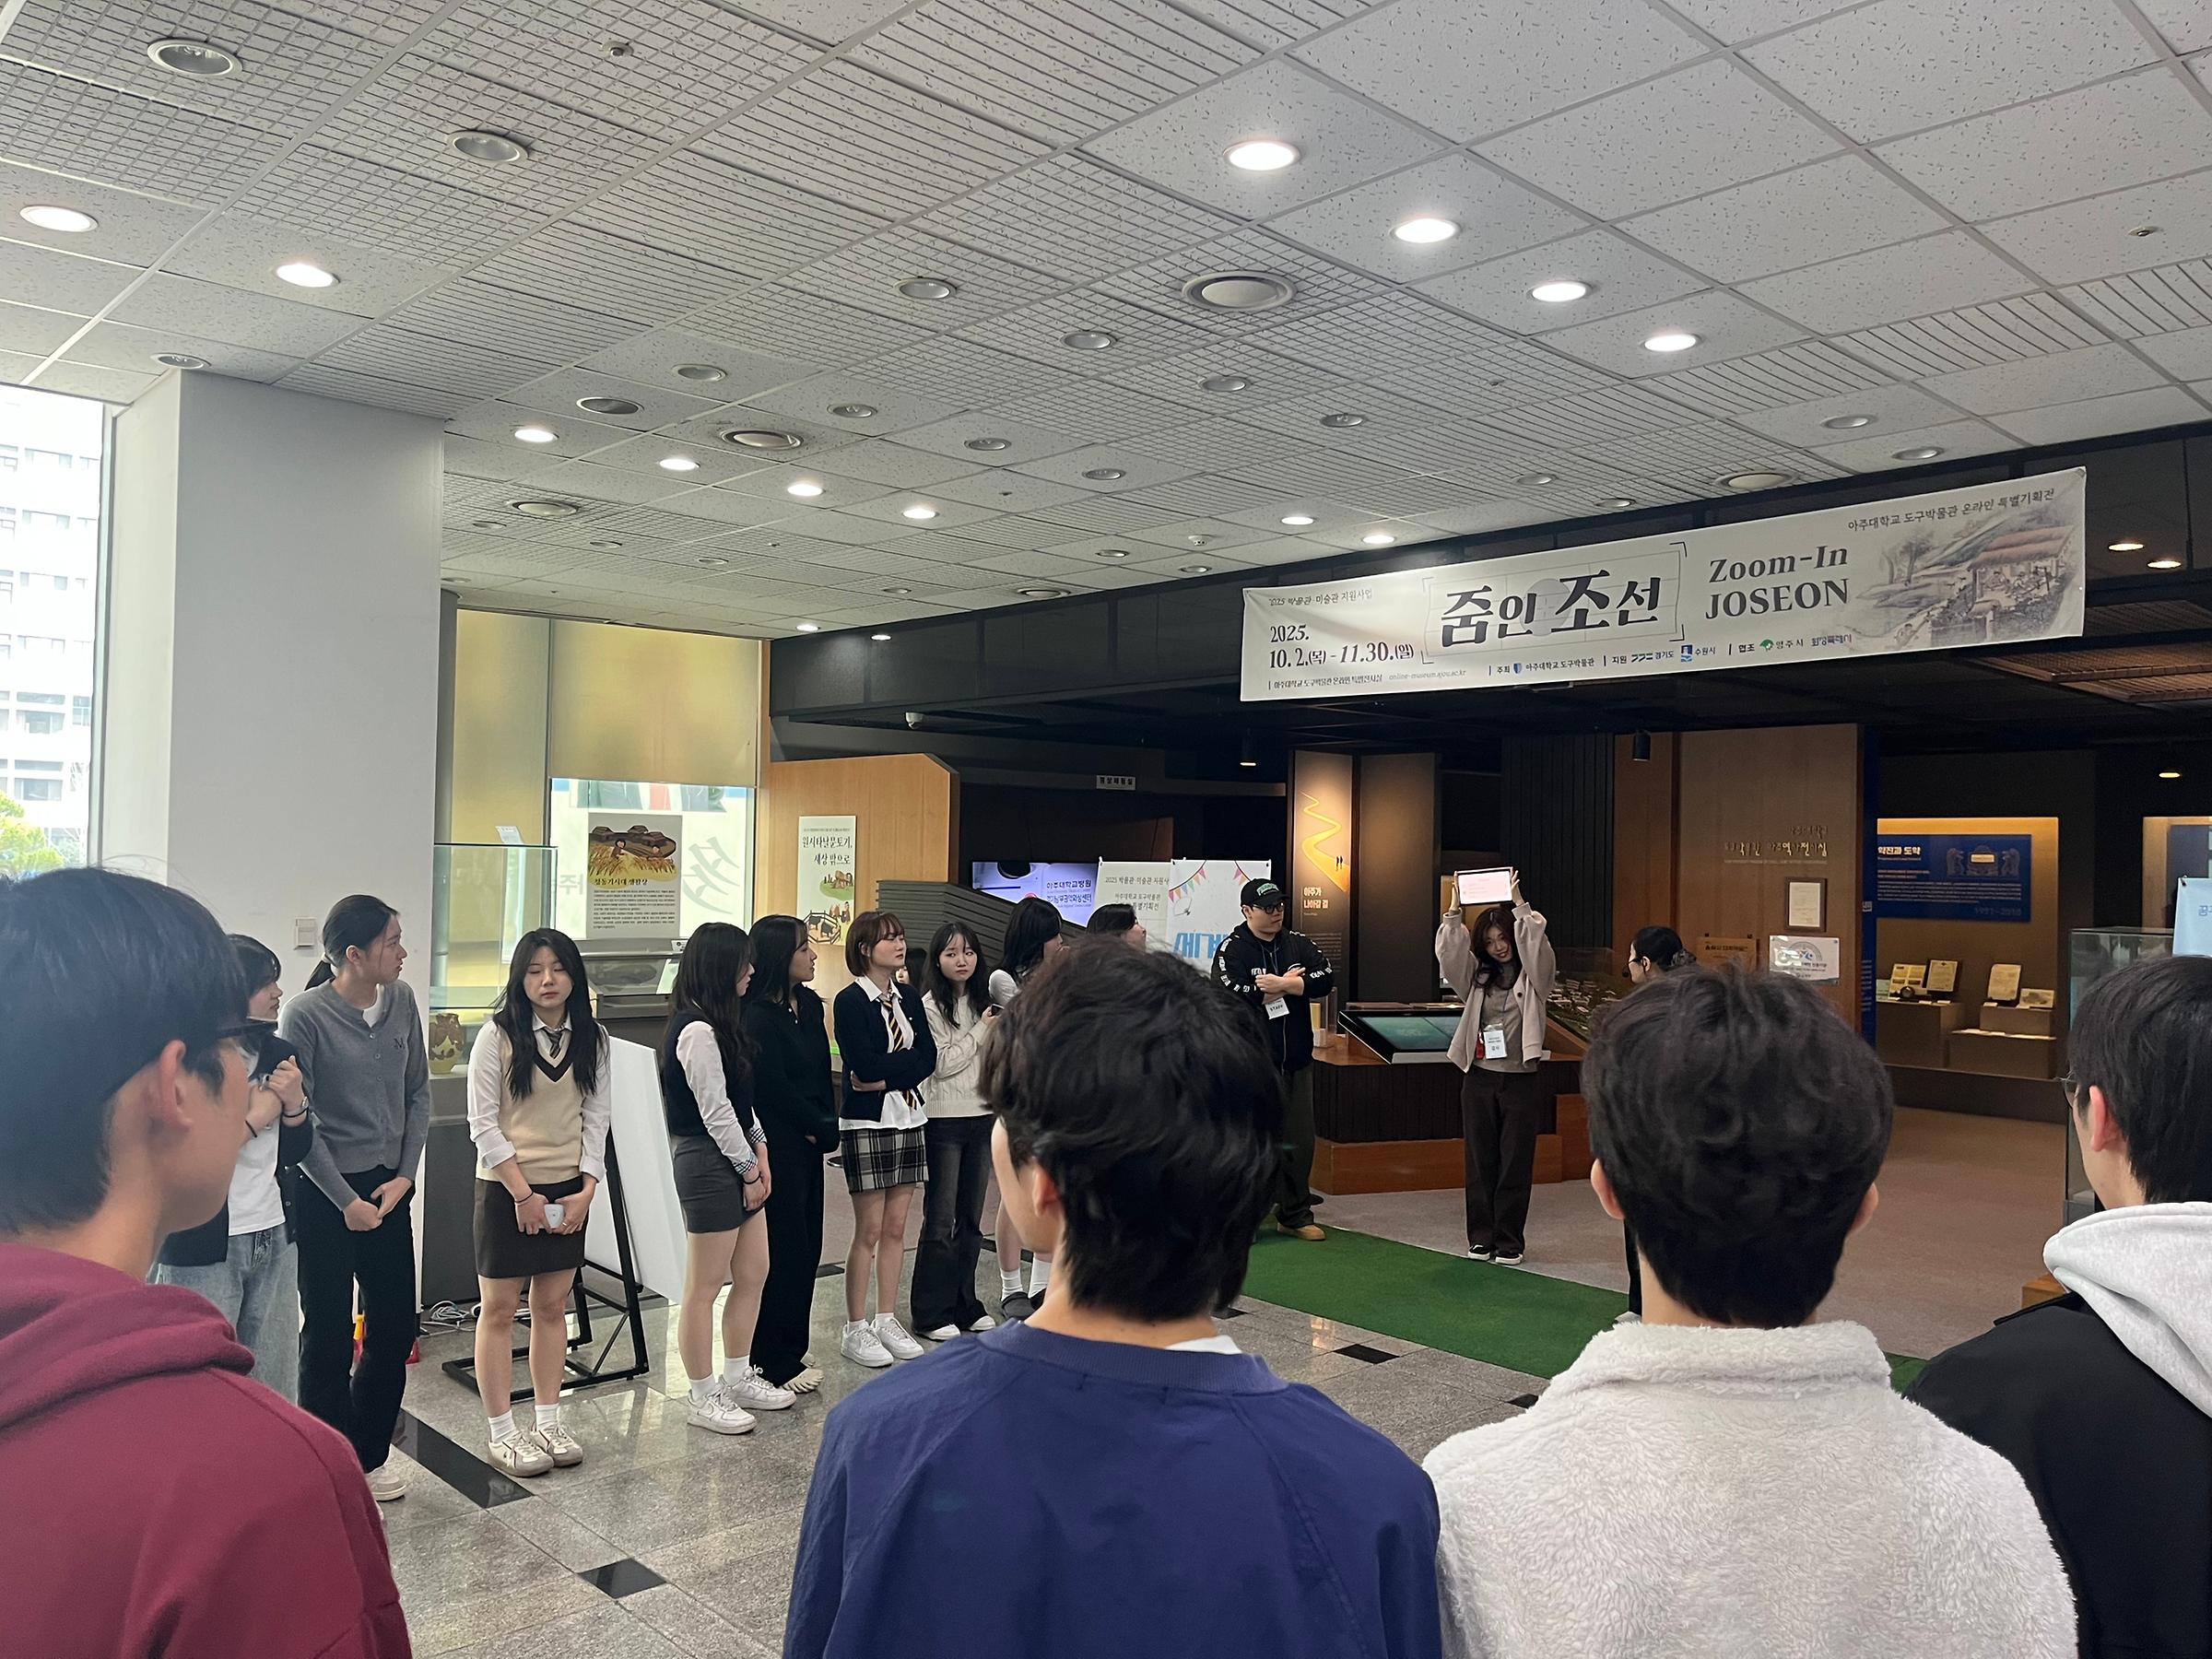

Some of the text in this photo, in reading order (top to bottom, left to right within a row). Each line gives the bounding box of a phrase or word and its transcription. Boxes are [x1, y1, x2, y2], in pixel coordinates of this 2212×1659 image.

[1848, 488, 2055, 532] 아주대학교 도구박물관 온라인 특별기획전
[1709, 545, 1849, 583] Zoom-In
[1441, 569, 1662, 648] 줌인 조선
[1705, 578, 1851, 619] JOSEON
[1270, 624, 1310, 643] 2025.
[1339, 641, 1414, 664] 11.30.(일)
[1525, 662, 1559, 671] 아주대학교
[1560, 657, 1594, 668] 도구박물관
[1612, 655, 1628, 665] 지원
[1655, 650, 1675, 660] 경기도
[1695, 645, 1716, 656] 수원시
[1738, 643, 1755, 653] 협조
